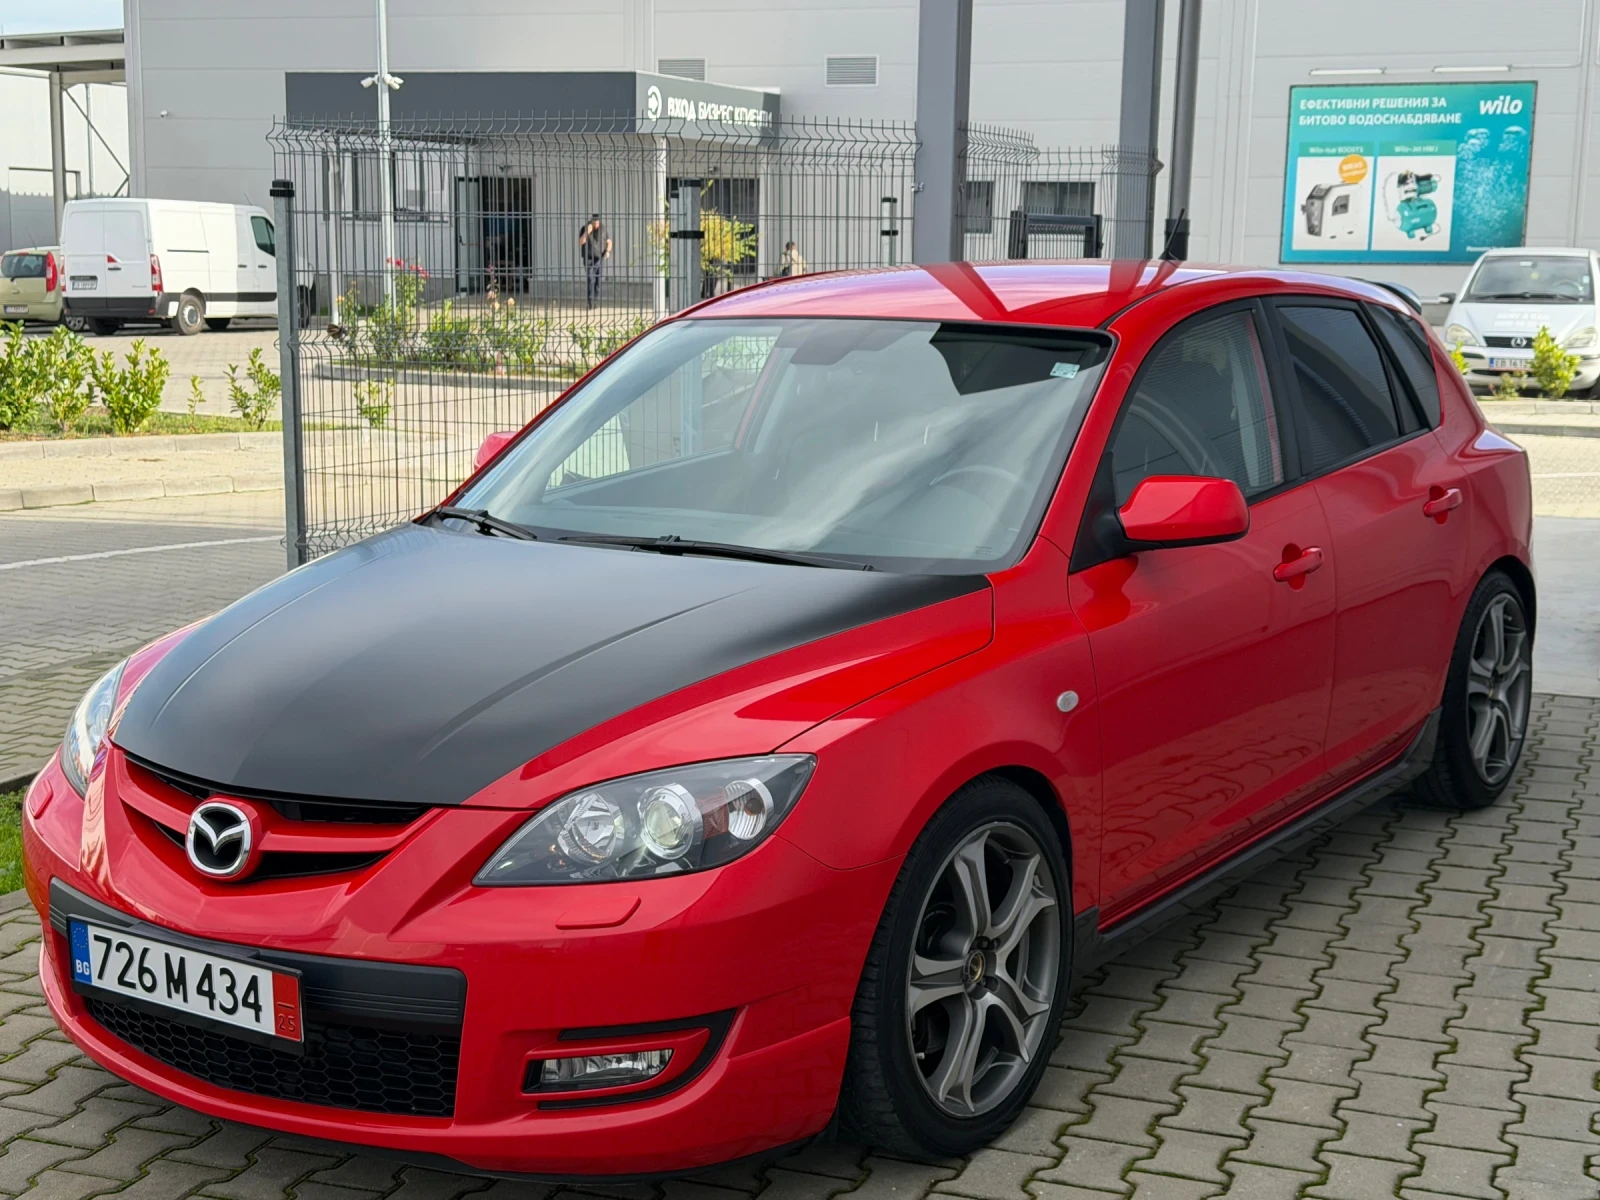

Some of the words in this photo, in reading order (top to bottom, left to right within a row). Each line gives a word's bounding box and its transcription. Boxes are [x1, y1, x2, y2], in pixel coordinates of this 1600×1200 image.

[667, 97, 697, 122] ВХОД
[698, 102, 734, 124] БИЗНЕС
[1300, 98, 1370, 110] ЕФЕКТИВНИ
[1372, 97, 1430, 109] РЕШЕНИЯ
[1431, 97, 1447, 108] ЗА
[1480, 95, 1523, 115] wilo
[1299, 114, 1347, 126] БИТОВО
[1349, 112, 1463, 127] ВОДОСНАБДЯВАНЕ
[75, 959, 90, 976] BG
[93, 934, 157, 994] 726
[164, 952, 189, 1004] M
[196, 963, 262, 1024] 434
[278, 1013, 296, 1033] 25
